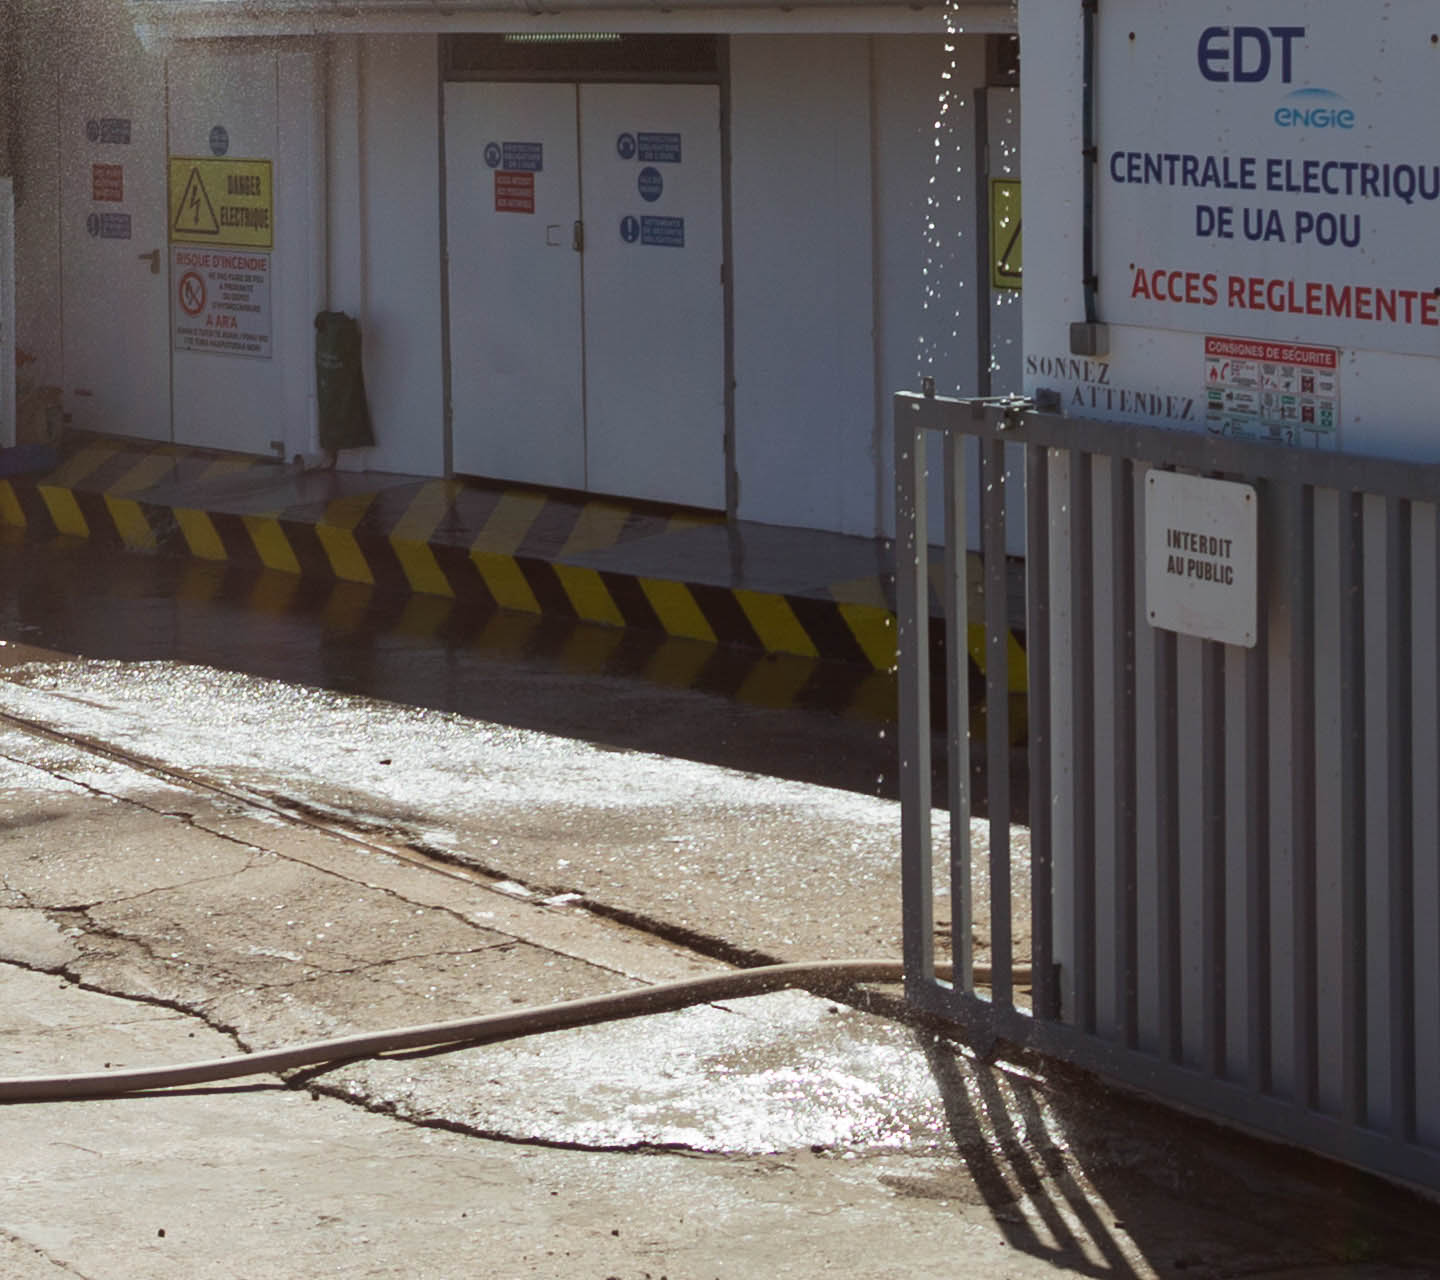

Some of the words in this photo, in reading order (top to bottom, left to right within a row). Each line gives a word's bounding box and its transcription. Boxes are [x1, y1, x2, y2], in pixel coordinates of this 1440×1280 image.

[1198, 26, 1305, 83] EDT
[227, 175, 262, 196] DANGER
[1110, 150, 1257, 191] CENTRALE
[1195, 205, 1234, 239] DE
[1243, 208, 1286, 242] UA
[1295, 211, 1361, 247] POU
[176, 252, 209, 269] RISQUE
[1131, 268, 1218, 306] ACCES
[1227, 276, 1440, 326] REGLEMENTE
[1207, 340, 1265, 358] CONSIGNES
[1266, 347, 1281, 359] DE
[1026, 354, 1110, 385] SONNEZ
[1071, 386, 1195, 421] ATTENDEZ
[1167, 528, 1232, 558] INTERDIT
[1167, 555, 1184, 576] AU
[1187, 559, 1233, 586] PUBLIC
